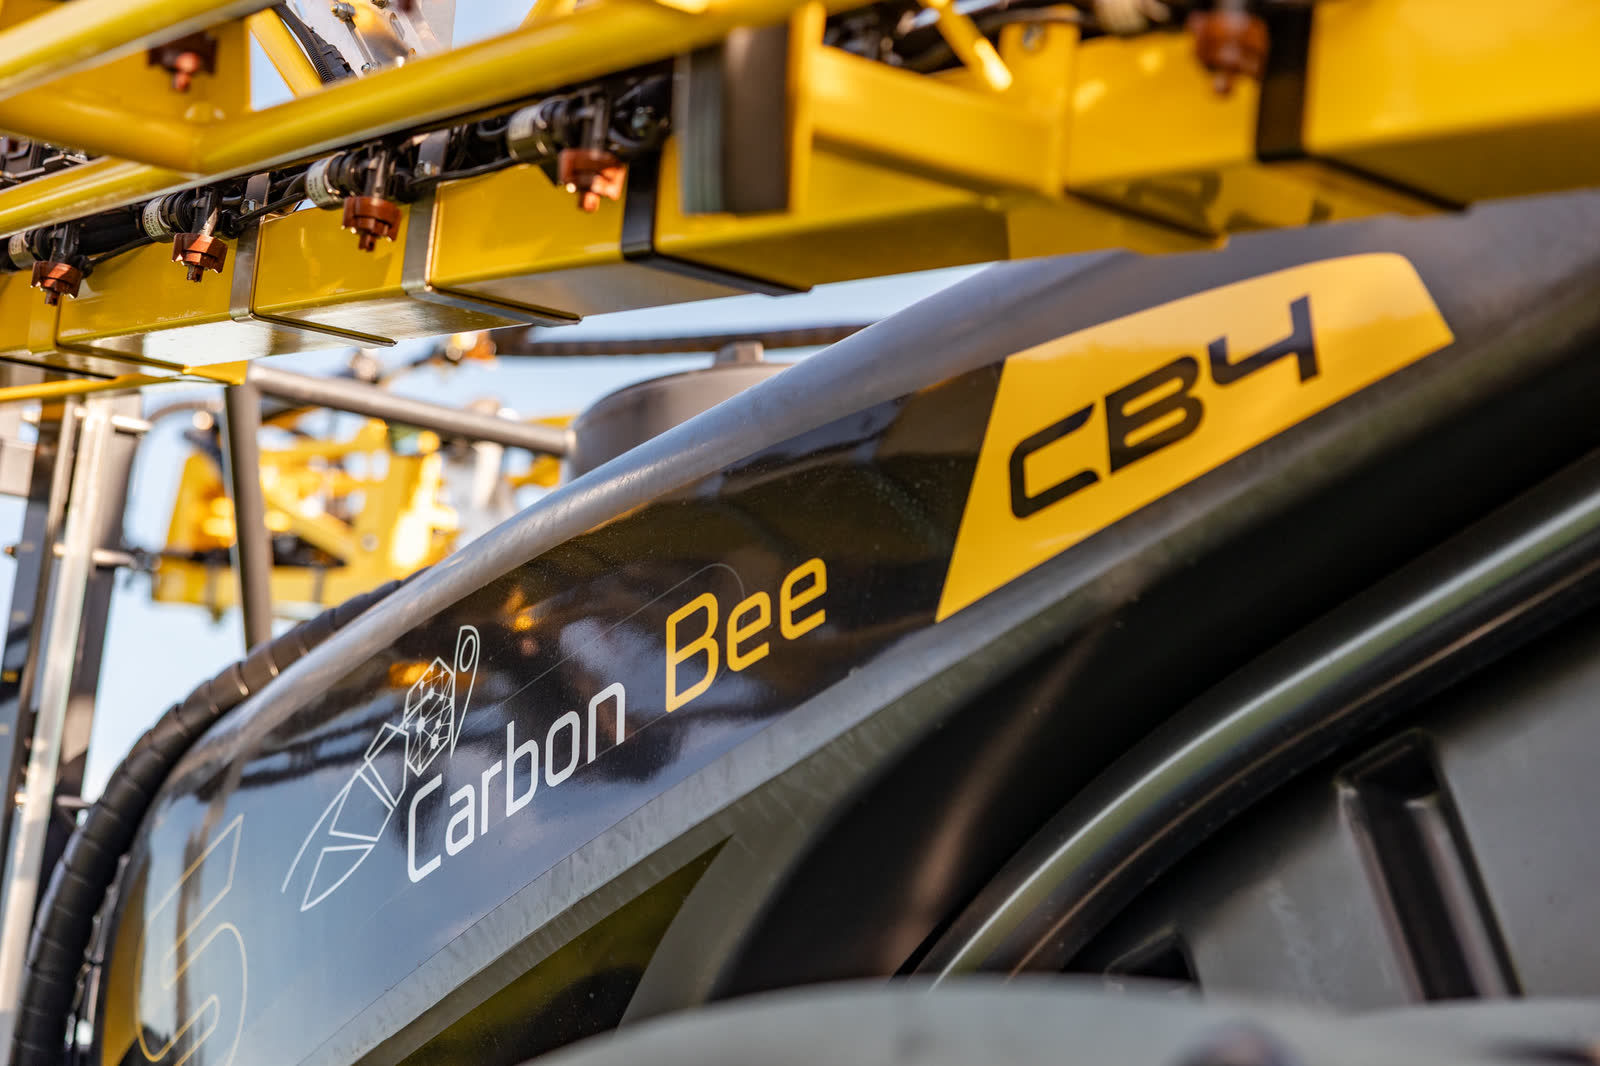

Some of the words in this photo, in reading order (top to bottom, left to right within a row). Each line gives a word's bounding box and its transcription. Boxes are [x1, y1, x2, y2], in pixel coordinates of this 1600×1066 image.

[1008, 293, 1321, 519] CB4
[407, 682, 626, 883] Carbon
[665, 557, 828, 713] Bee
